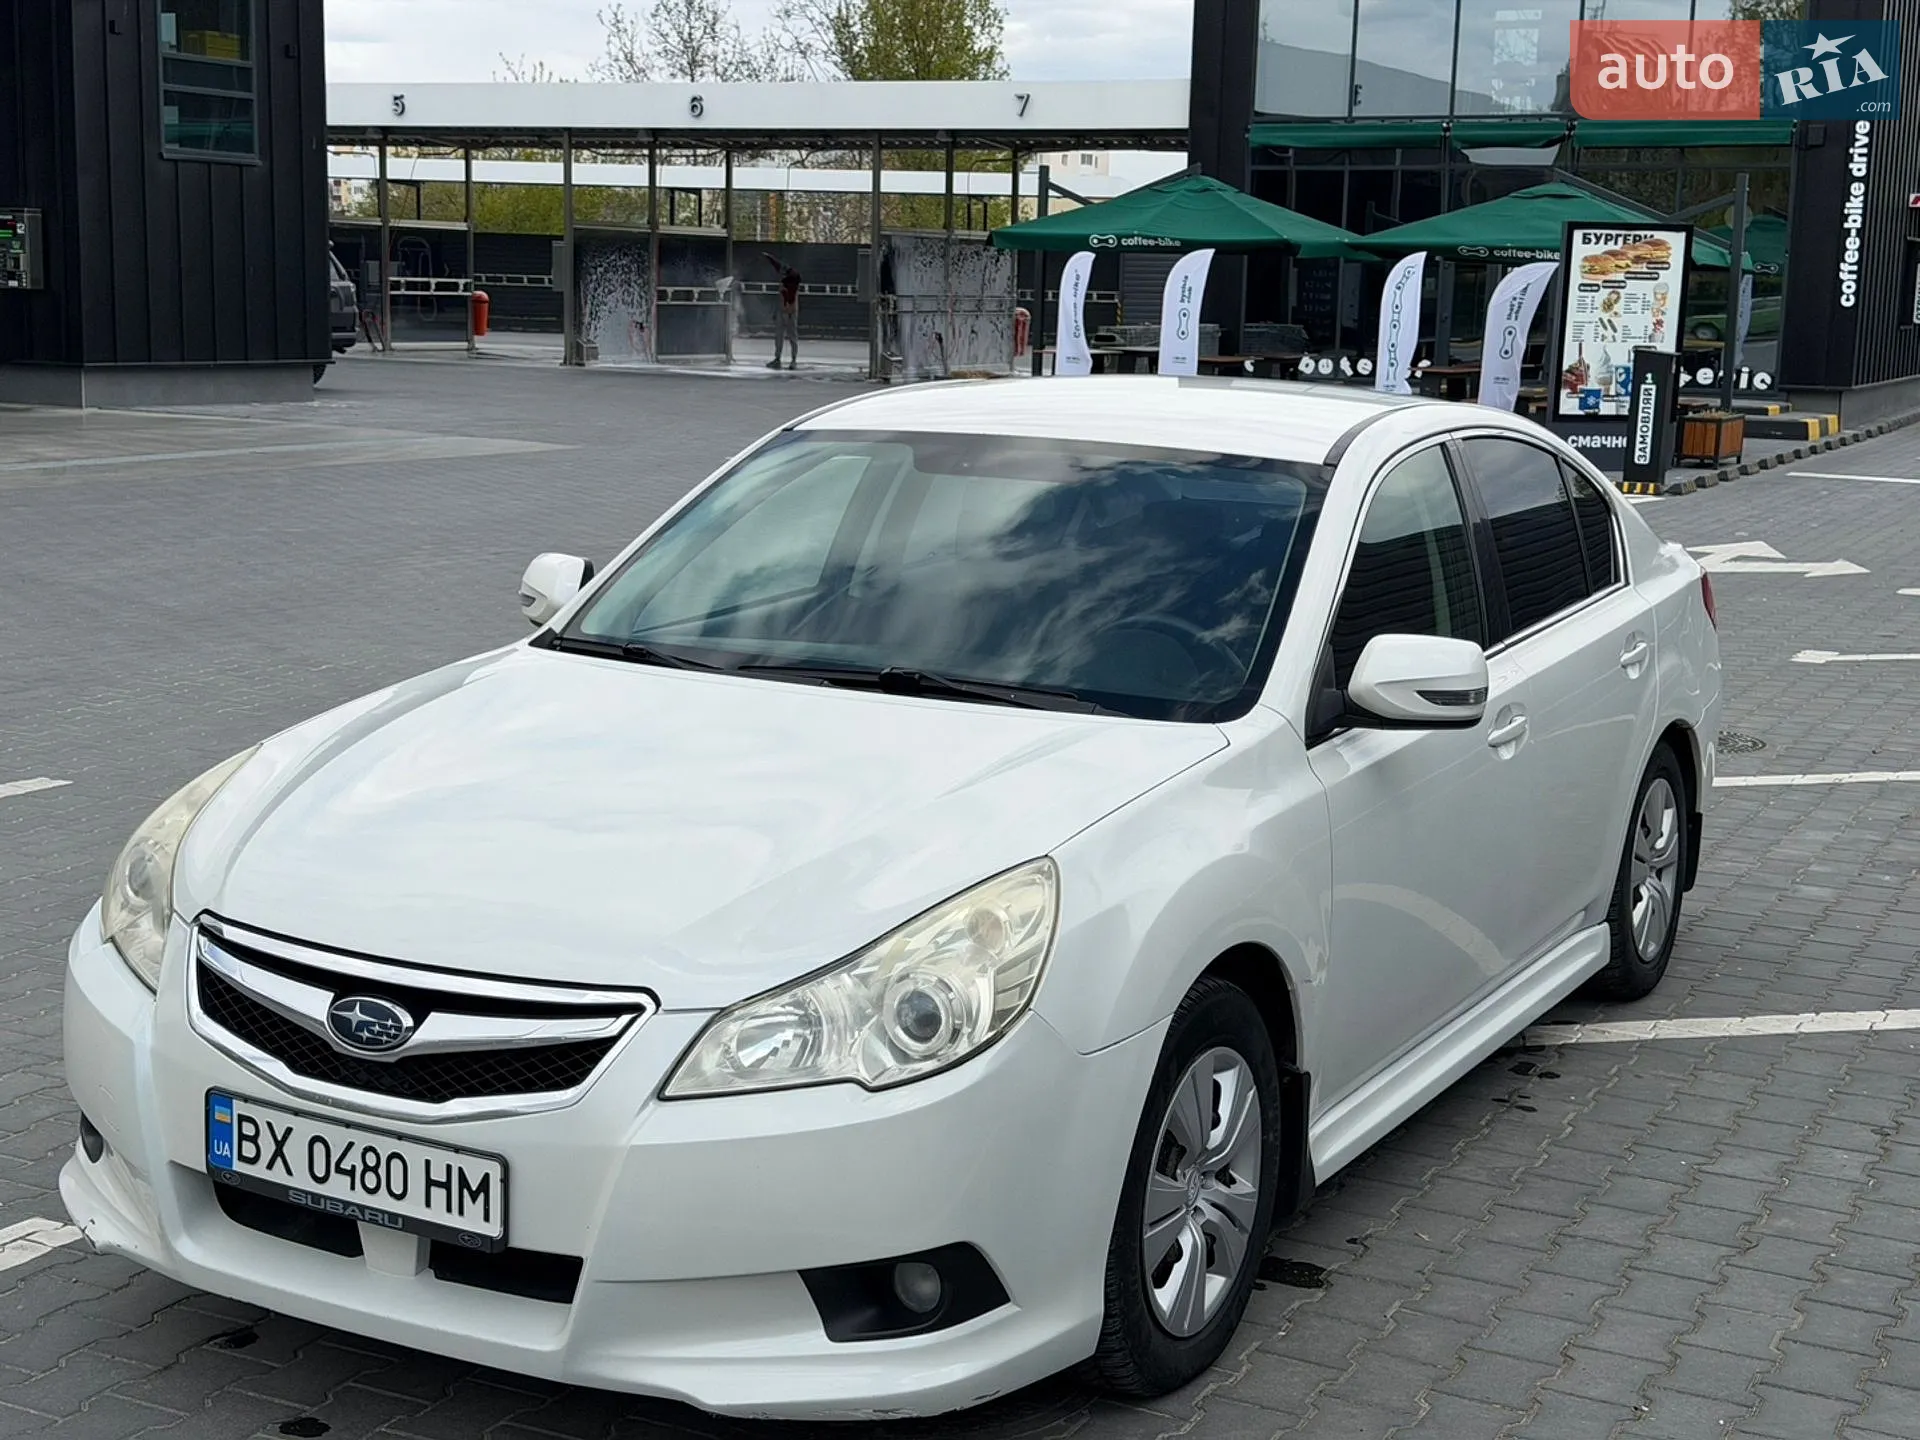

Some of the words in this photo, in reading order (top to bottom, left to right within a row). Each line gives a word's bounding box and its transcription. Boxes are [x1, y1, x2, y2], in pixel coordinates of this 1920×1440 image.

[393, 94, 405, 116] 5
[690, 95, 703, 117] 6
[1014, 93, 1030, 117] 7
[1849, 120, 1870, 177] drive
[1121, 236, 1181, 247] coffee-bike
[1839, 181, 1866, 307] coffee-bike
[1493, 249, 1560, 260] coffee-bike
[1645, 373, 1653, 384] 1
[1637, 387, 1653, 462] ЗАМОВЛЯЙ
[213, 1138, 231, 1159] UA
[237, 1113, 294, 1177] BX
[307, 1134, 409, 1201] 0480
[424, 1158, 491, 1223] HM
[288, 1188, 404, 1229] SUBARU
